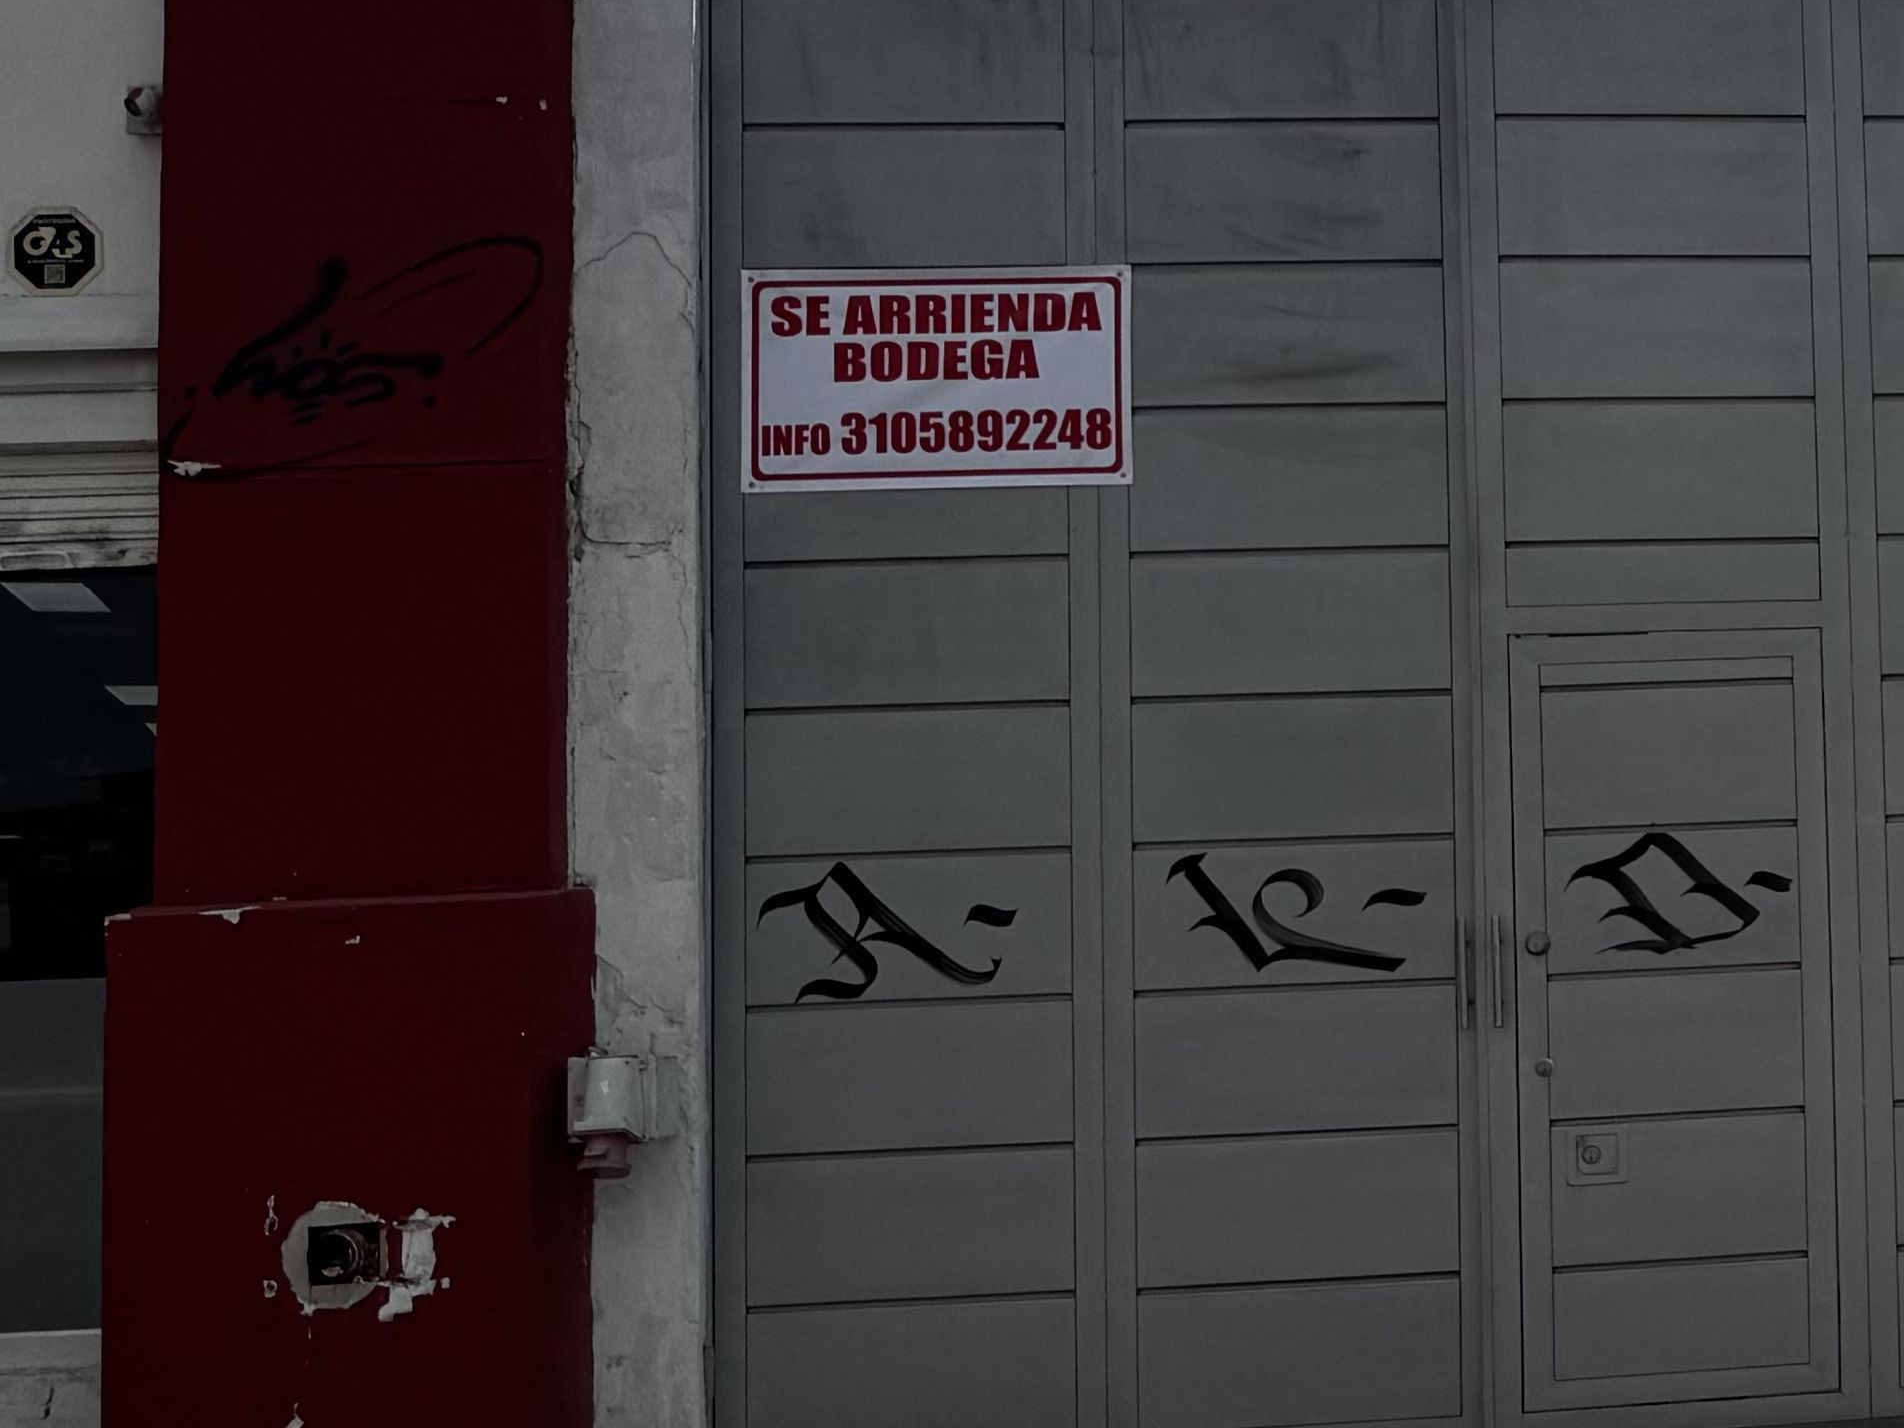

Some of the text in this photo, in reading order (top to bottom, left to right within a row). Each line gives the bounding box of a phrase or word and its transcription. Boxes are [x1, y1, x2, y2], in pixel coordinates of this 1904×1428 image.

[23, 226, 83, 259] G4S
[770, 292, 1102, 337] SE ARRIENDA
[834, 339, 1040, 383] BODEGA
[761, 408, 1112, 457] INFO 3105892248
